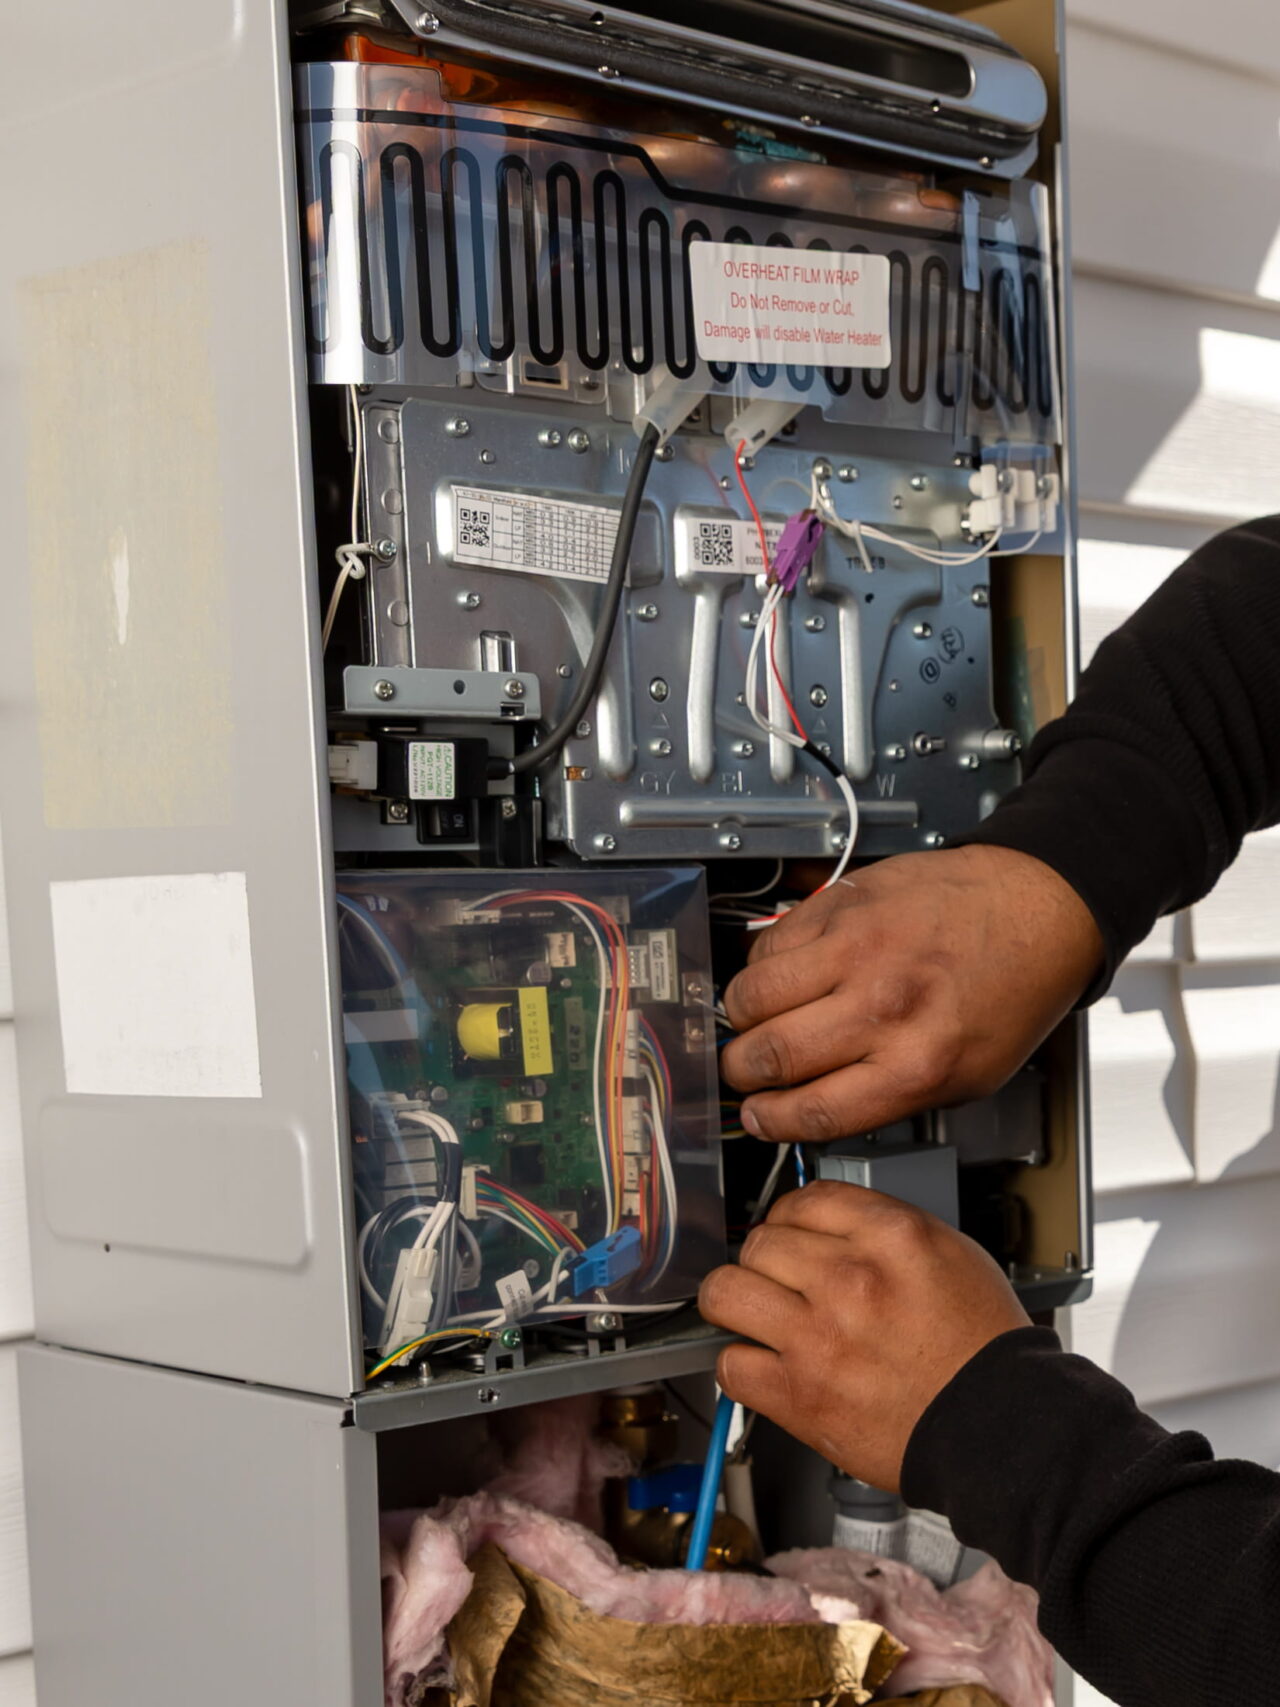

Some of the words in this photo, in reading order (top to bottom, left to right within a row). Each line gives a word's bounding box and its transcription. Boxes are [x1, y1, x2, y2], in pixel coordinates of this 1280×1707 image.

[723, 261, 790, 282] OVERHEAT
[793, 267, 821, 283] FILM
[824, 269, 859, 286] WRAP
[730, 292, 747, 309] Do
[751, 294, 769, 310] Not
[772, 295, 816, 313] Remove
[819, 302, 830, 314] or
[704, 320, 751, 343] Damage
[755, 325, 770, 340] will
[774, 324, 811, 344] disable
[813, 328, 845, 344] Water
[848, 330, 882, 346] Heater
[444, 755, 453, 797] CAUTION
